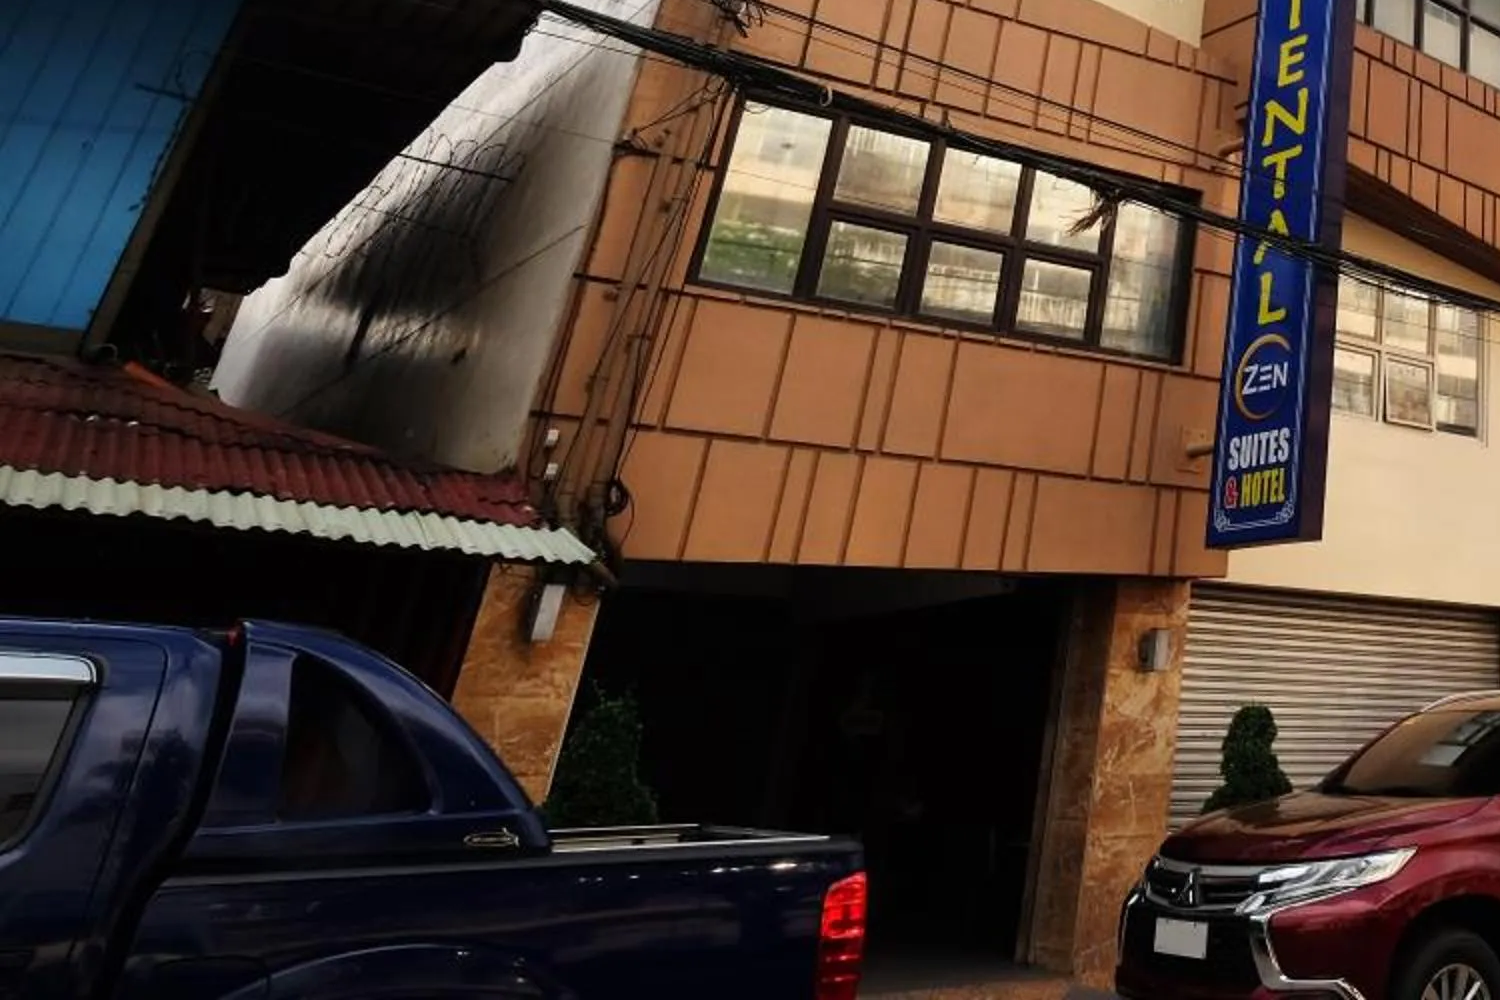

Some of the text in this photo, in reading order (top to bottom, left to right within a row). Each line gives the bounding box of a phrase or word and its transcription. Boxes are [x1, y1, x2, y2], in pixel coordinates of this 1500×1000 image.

[1242, 361, 1288, 395] ZEN
[1227, 428, 1290, 471] SUITES
[1240, 468, 1286, 509] HOTEL
